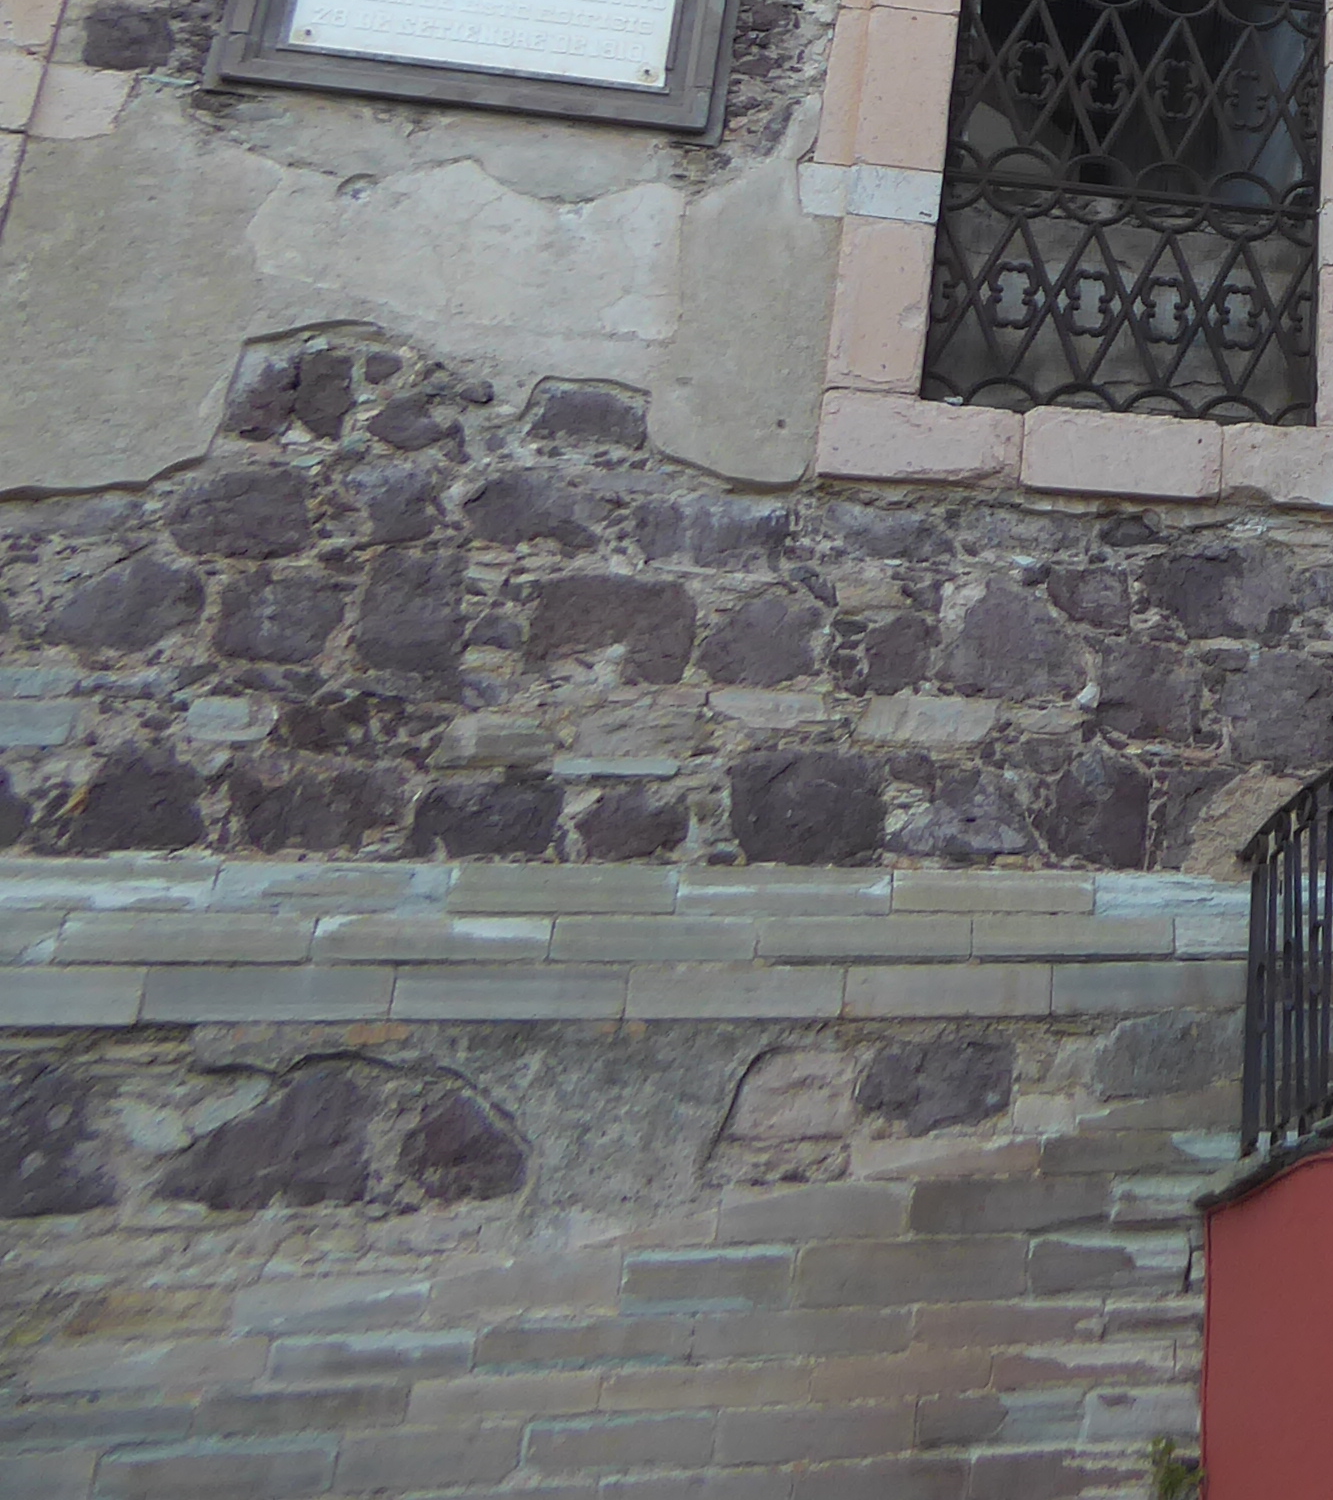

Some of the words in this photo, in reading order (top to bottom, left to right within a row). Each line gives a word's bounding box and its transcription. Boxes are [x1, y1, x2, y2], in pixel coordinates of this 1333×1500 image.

[310, 7, 348, 28] 28
[352, 11, 391, 33] DE
[395, 15, 546, 52] SETIEMBRE
[549, 34, 586, 56] DE
